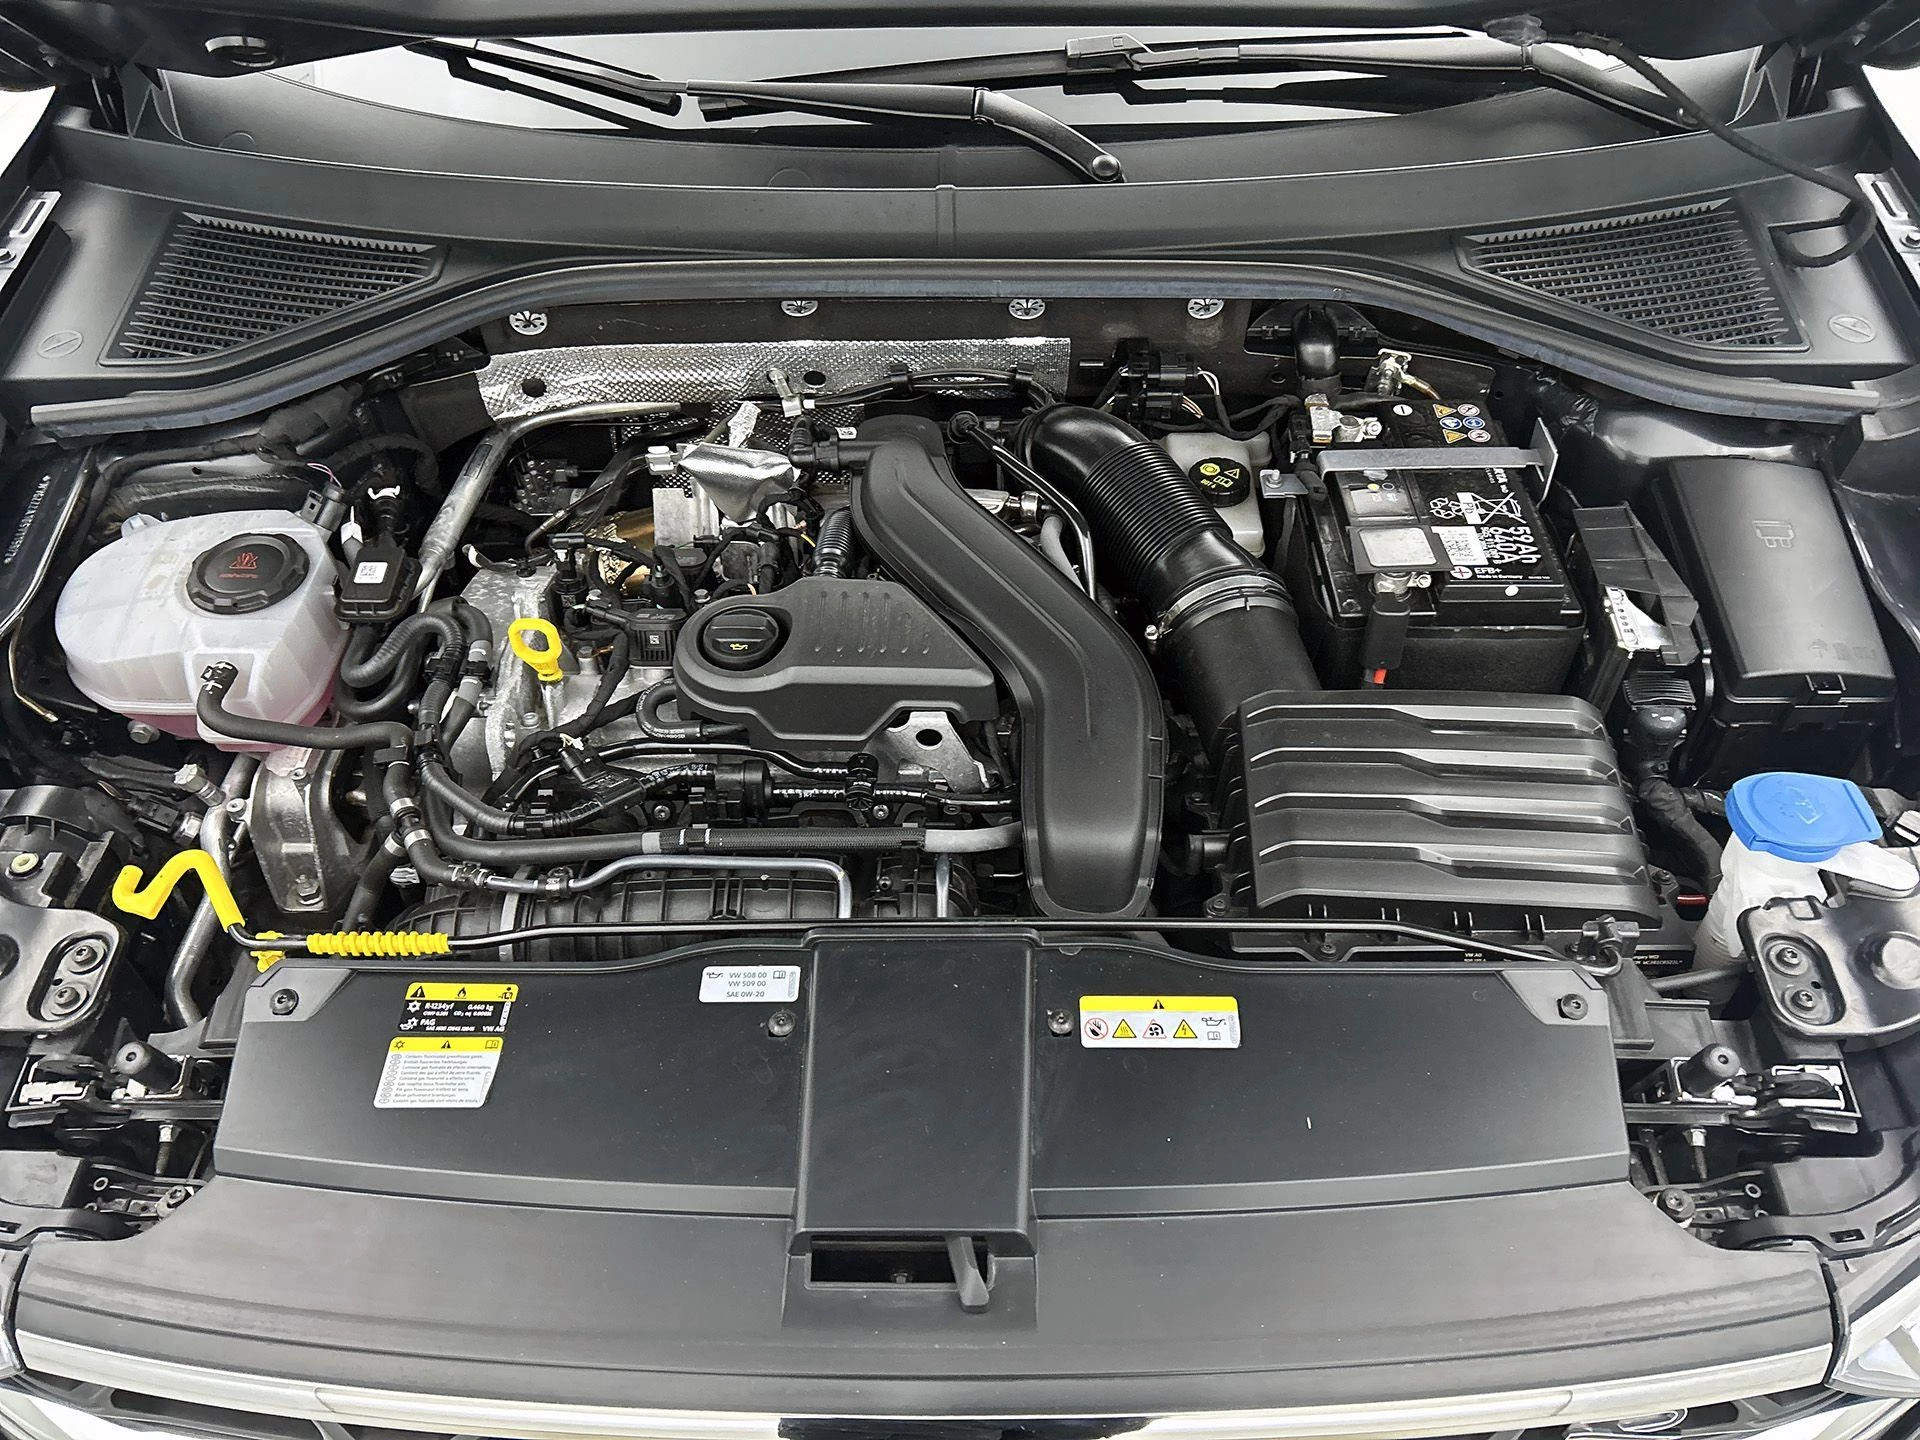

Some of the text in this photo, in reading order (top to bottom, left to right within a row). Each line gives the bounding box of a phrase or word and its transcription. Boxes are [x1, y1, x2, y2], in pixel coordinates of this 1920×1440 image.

[1489, 526, 1521, 564] 640A
[1509, 526, 1542, 564] 59Ah
[424, 1002, 454, 1011] R-1234yf
[485, 1004, 494, 1012] kg
